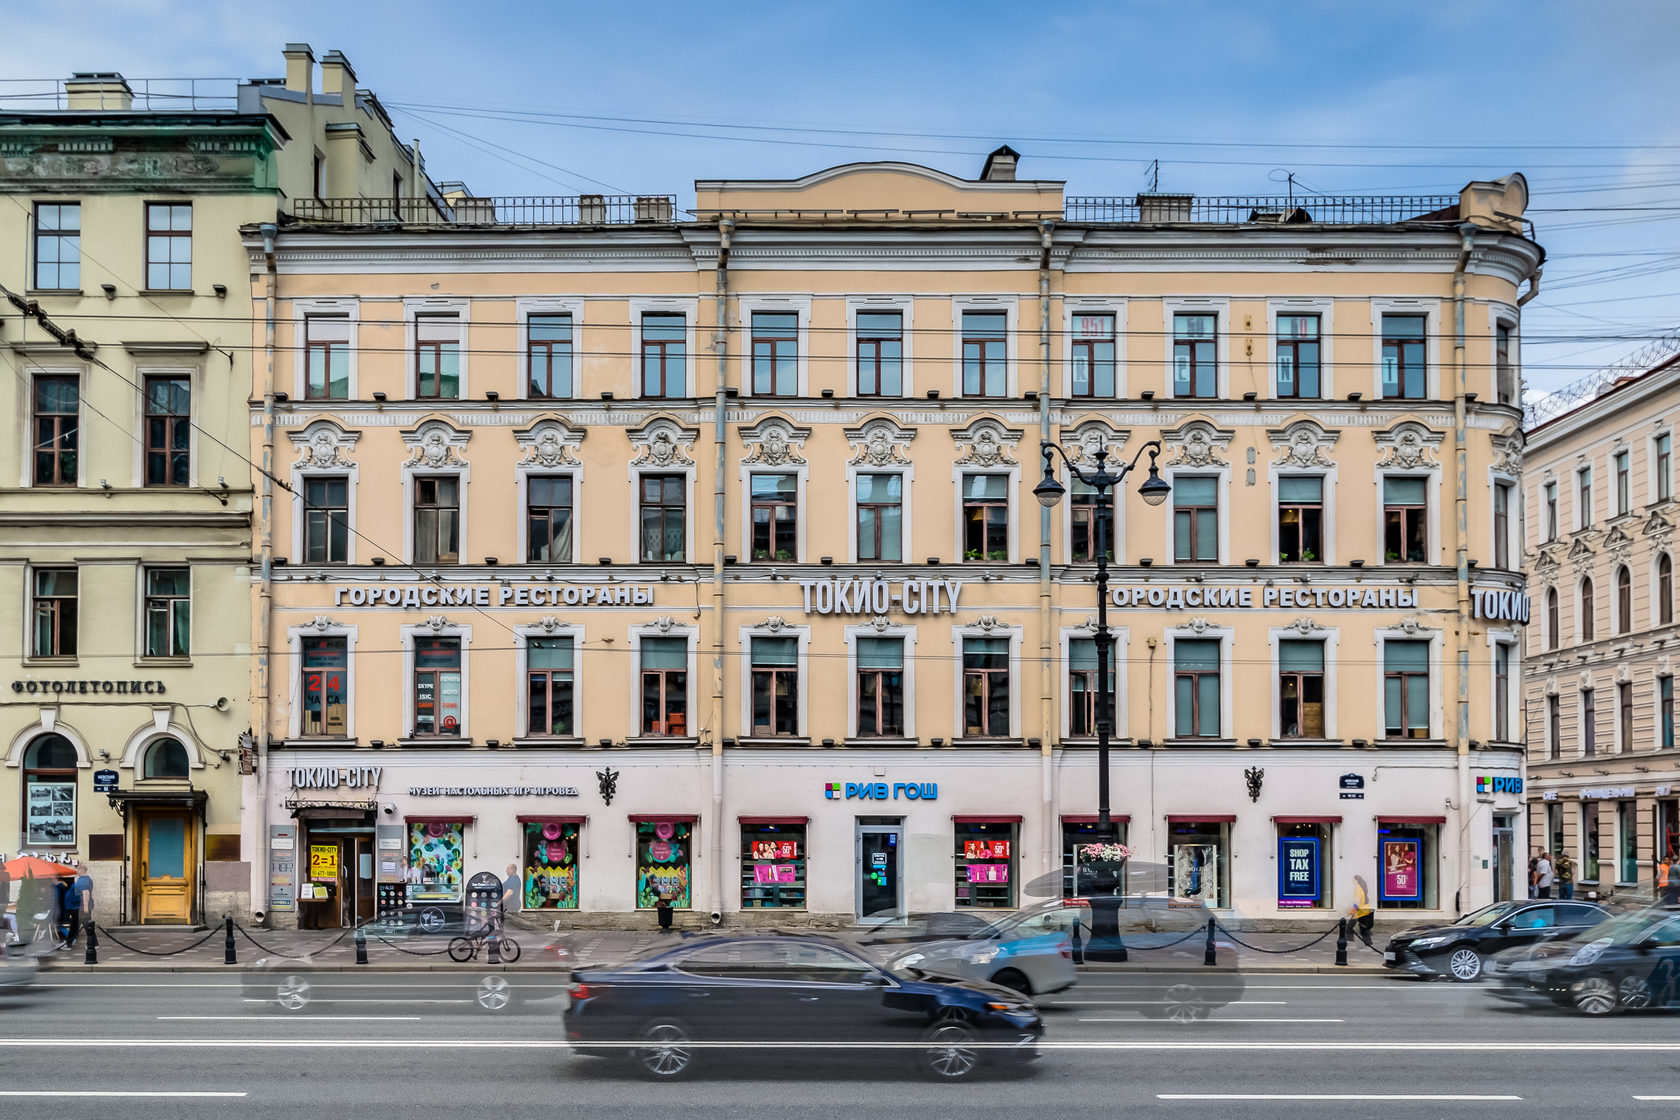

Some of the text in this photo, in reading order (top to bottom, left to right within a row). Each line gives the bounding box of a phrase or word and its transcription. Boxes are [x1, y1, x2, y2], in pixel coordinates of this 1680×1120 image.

[334, 585, 655, 609] ГОРОДСКИЕ РЕСТОРАНЫ
[1097, 586, 1418, 610] ОРОДСКИЕ РЕСТОРАНЫ
[12, 680, 166, 694] ФОТОЛЕТОПИСЬ
[308, 674, 340, 691] 24
[444, 786, 509, 796] НАСТОЛЬНЫХ
[512, 786, 530, 796] ИГР
[534, 786, 579, 796] ИГРОВЕД
[845, 782, 938, 801] РИВ ГОШ
[1493, 776, 1523, 793] РИВ
[1289, 848, 1309, 858] SHOP
[1289, 858, 1309, 870] TAX
[1289, 871, 1310, 882] FREE
